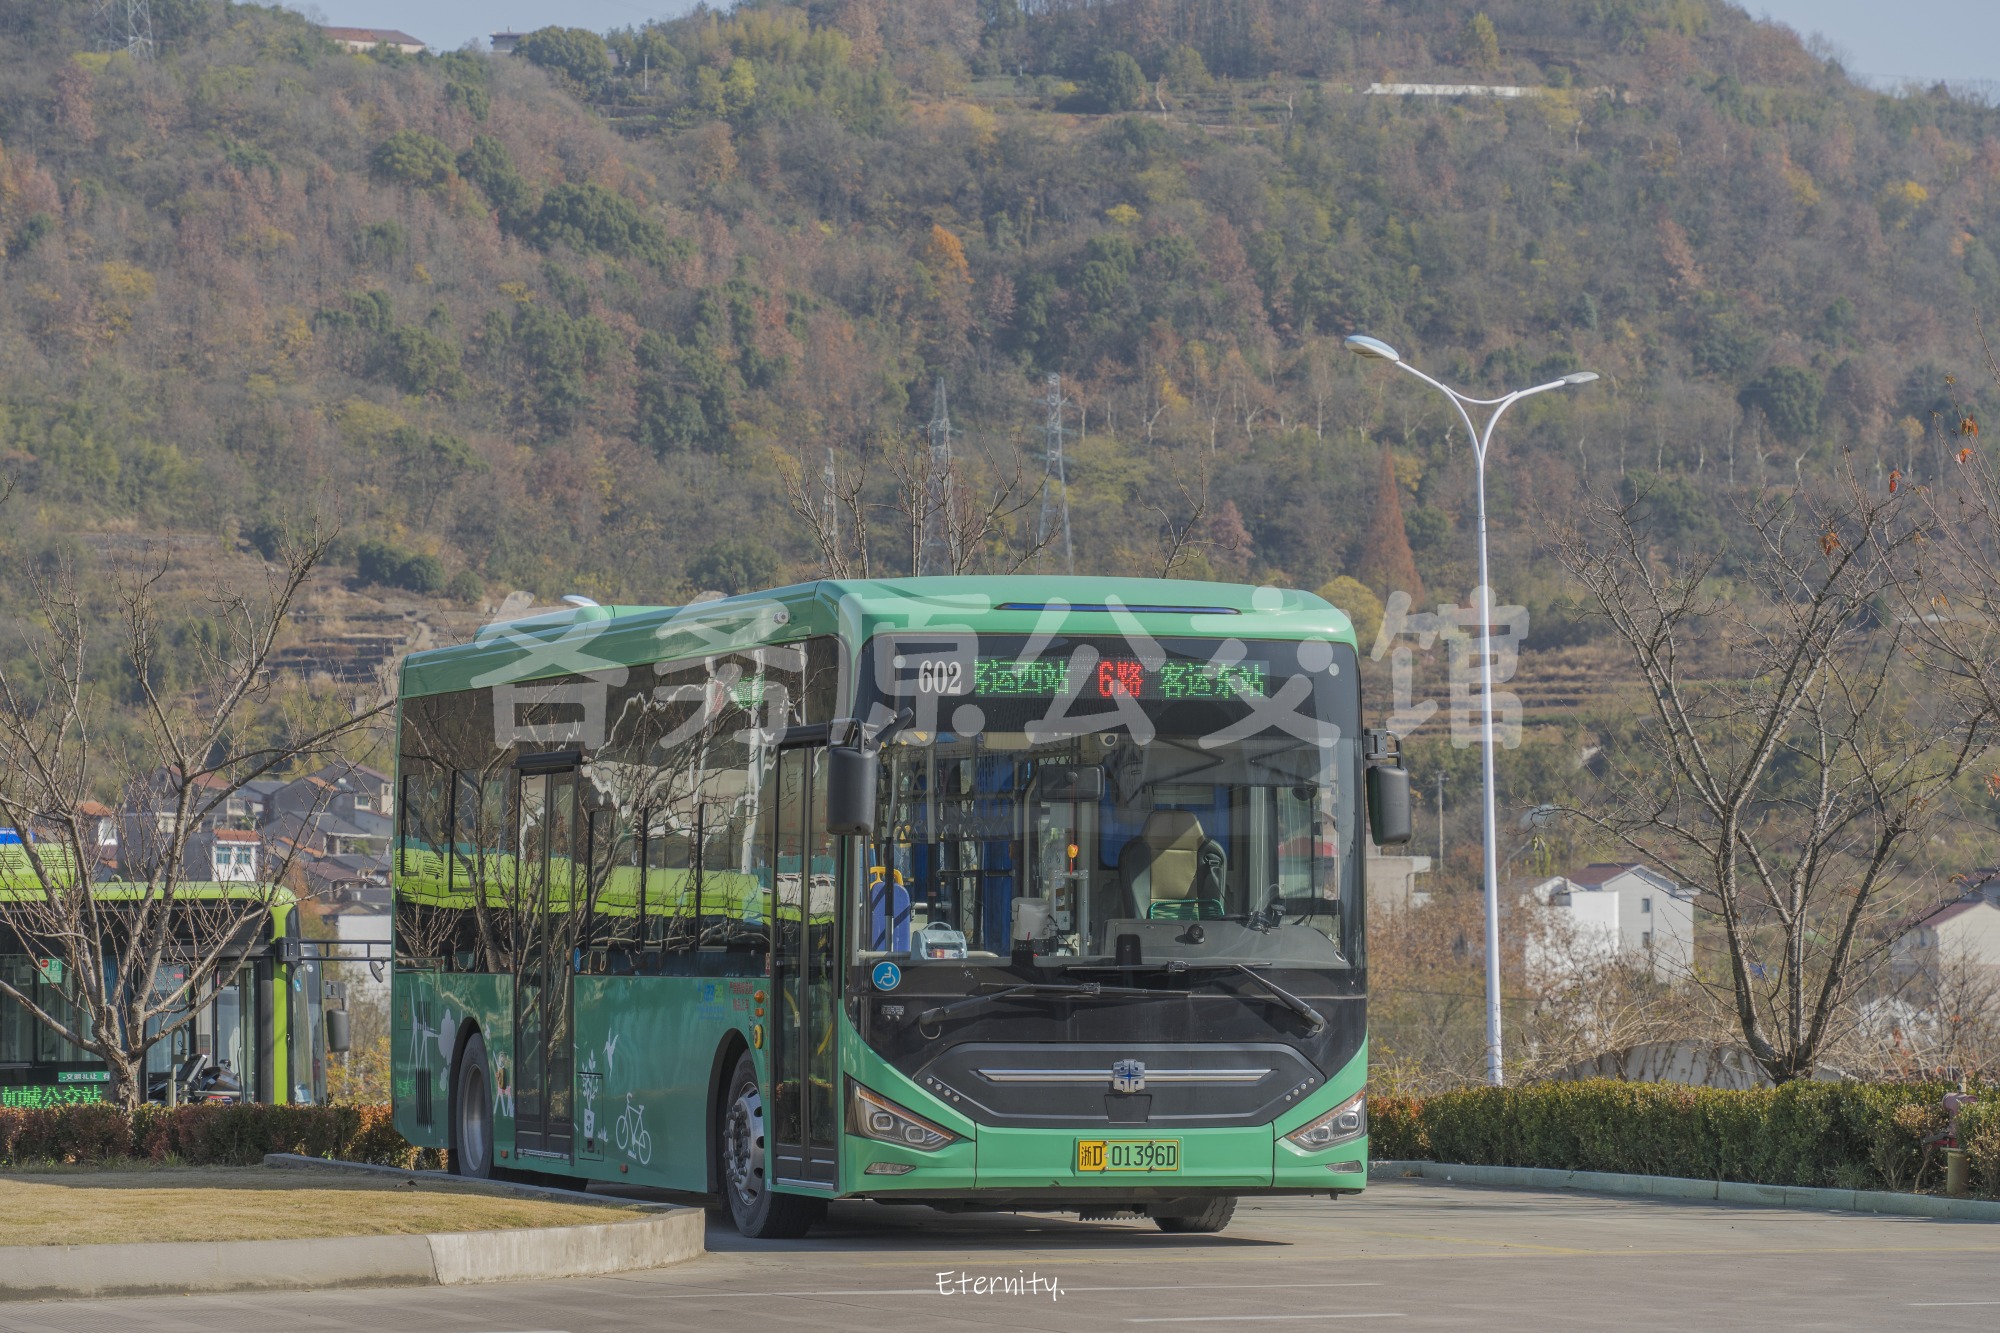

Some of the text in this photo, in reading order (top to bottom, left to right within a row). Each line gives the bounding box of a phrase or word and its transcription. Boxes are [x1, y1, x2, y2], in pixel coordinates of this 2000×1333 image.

[918, 660, 962, 694] 602
[1099, 661, 1144, 697] 6路
[1159, 662, 1266, 698] 客运东站
